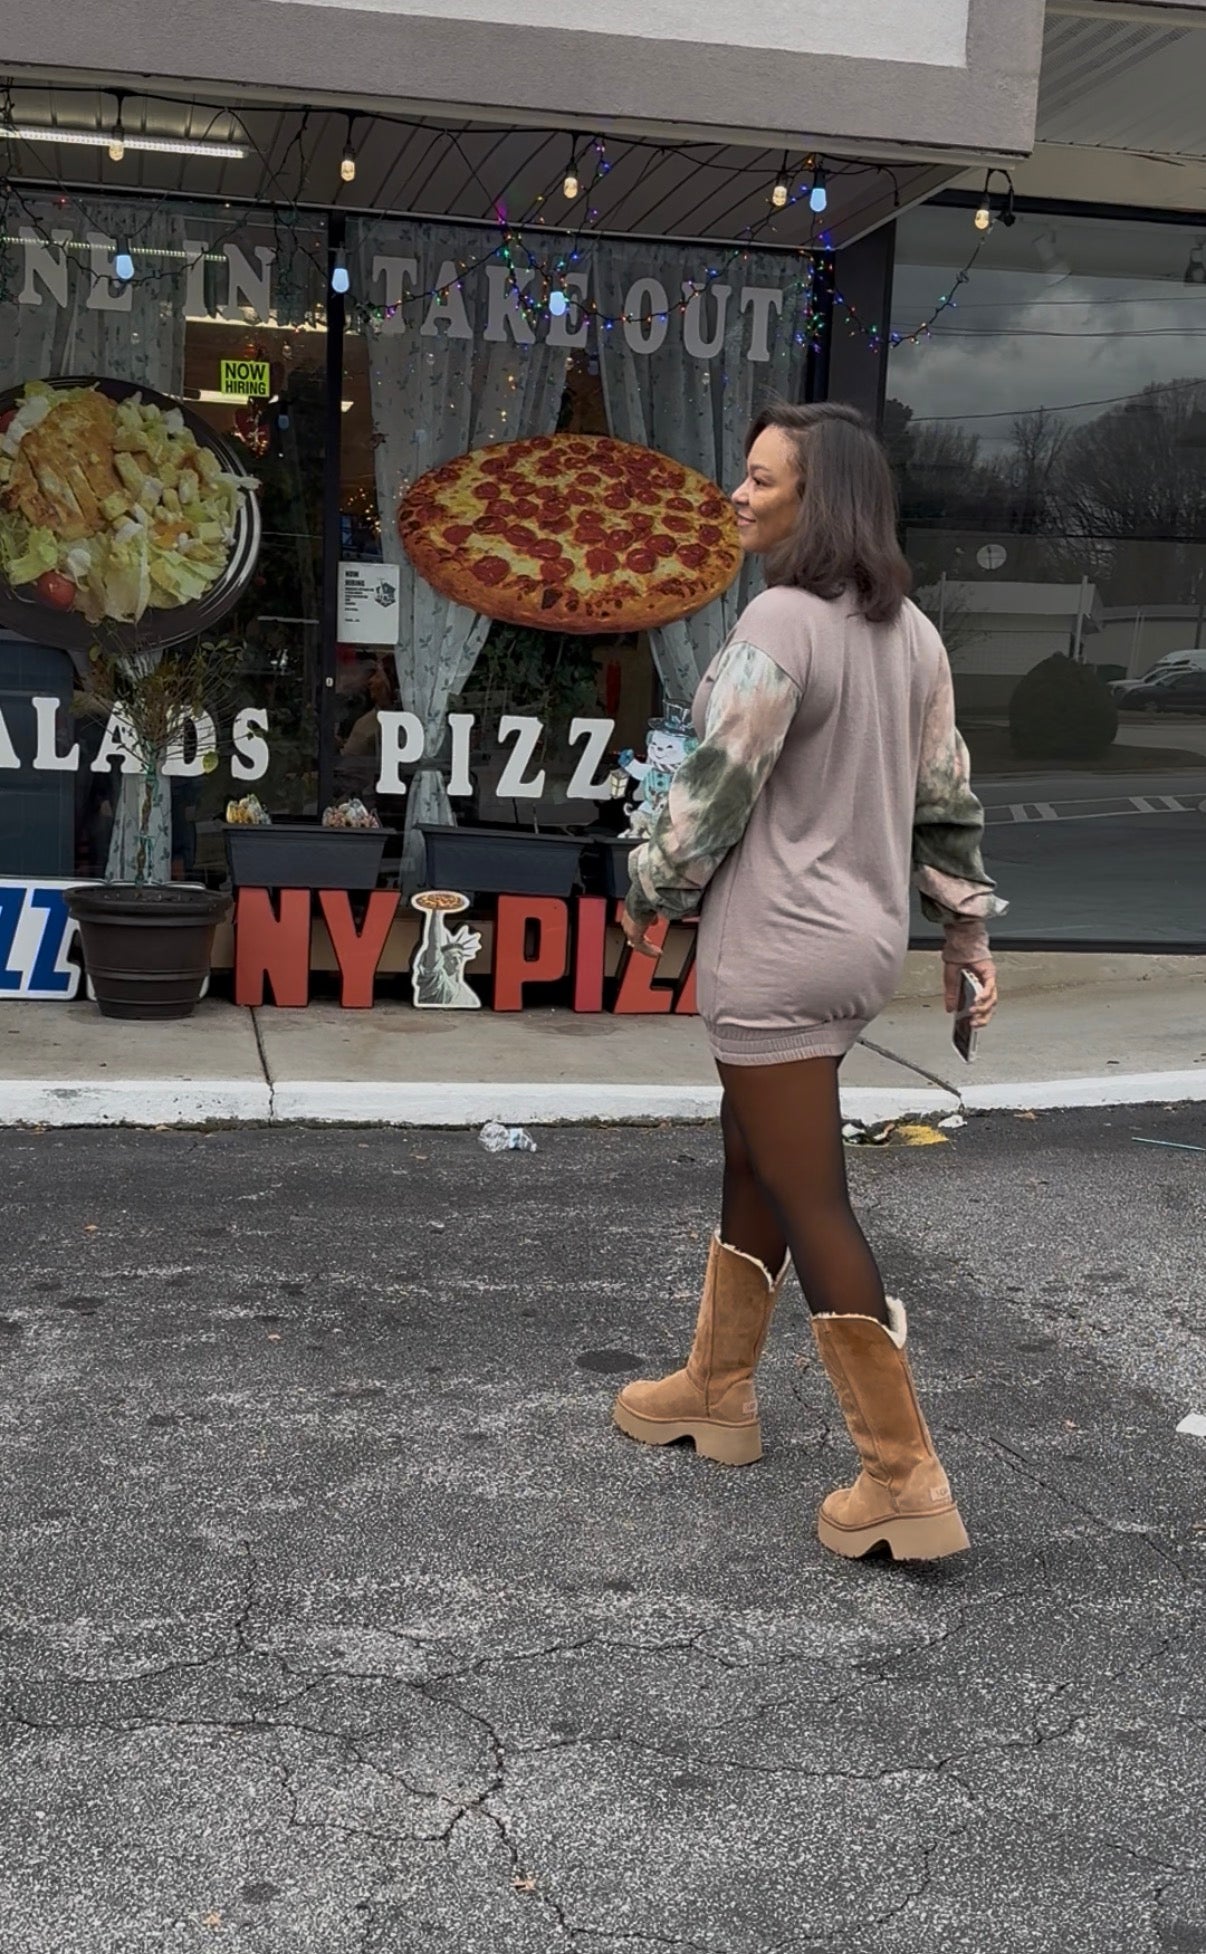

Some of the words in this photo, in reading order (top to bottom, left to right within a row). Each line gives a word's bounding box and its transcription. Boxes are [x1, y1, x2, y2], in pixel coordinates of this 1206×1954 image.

[182, 239, 275, 325] IN
[372, 255, 589, 348] TAKE
[622, 277, 783, 362] OUT
[225, 363, 266, 380] NOW
[225, 381, 266, 395] HIRING
[235, 886, 401, 1008] NY
[493, 894, 699, 1014] PIZ
